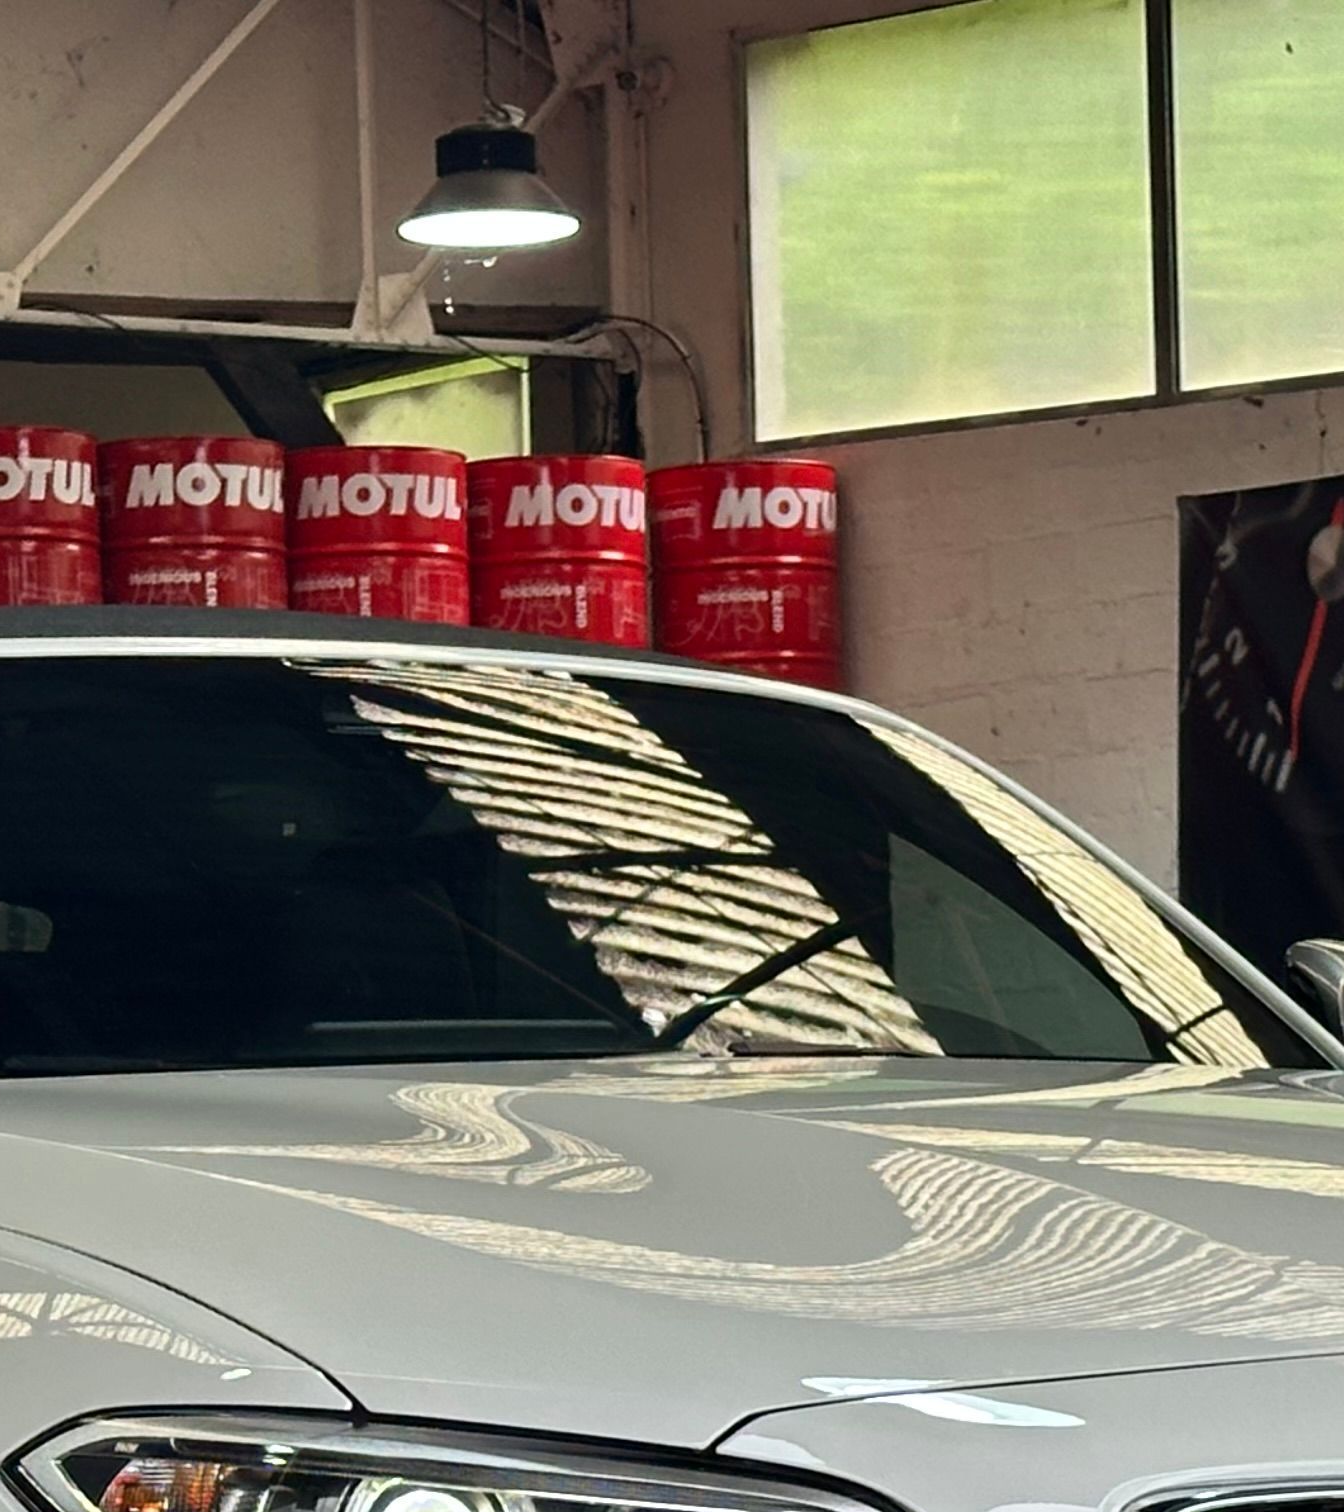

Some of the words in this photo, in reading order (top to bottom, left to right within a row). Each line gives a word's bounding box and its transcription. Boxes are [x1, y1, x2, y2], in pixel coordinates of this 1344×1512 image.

[297, 473, 461, 520] MOTUL
[505, 484, 645, 533] MOTU
[712, 486, 837, 533] MOTU
